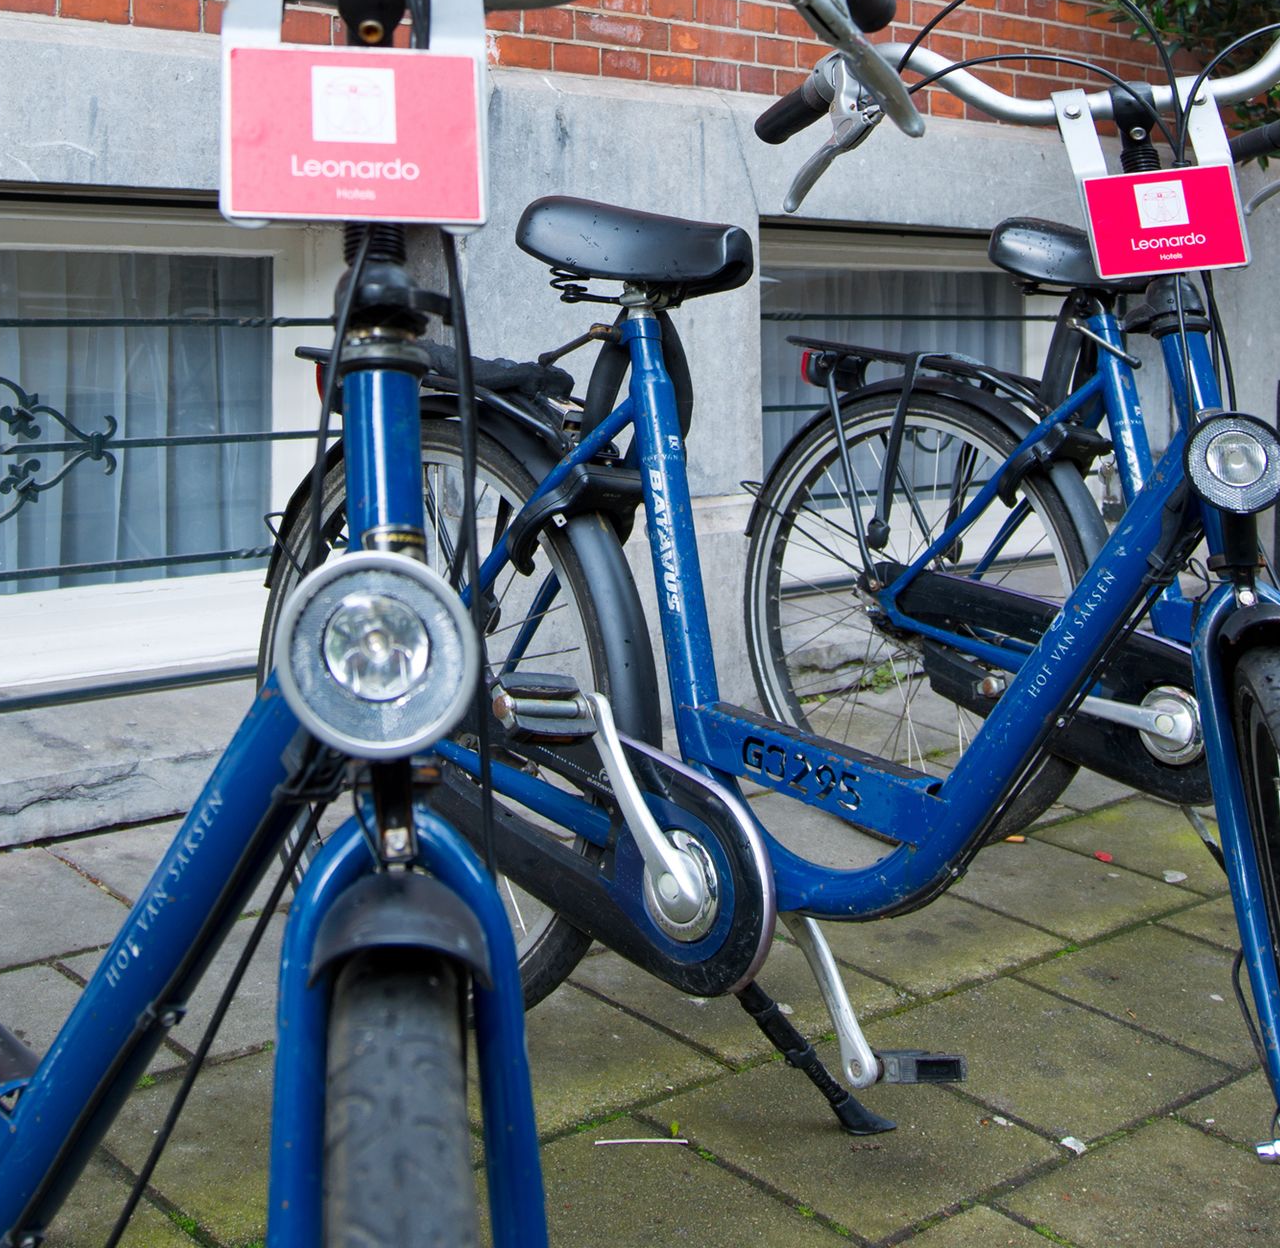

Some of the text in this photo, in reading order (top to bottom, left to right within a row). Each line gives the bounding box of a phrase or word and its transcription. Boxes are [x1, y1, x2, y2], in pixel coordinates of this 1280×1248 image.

[290, 154, 420, 181] Leonardo
[336, 187, 376, 201] Hotels
[1130, 232, 1206, 251] Leonardo
[1159, 252, 1183, 261] Hotels
[648, 467, 680, 613] BATAVUS
[1027, 663, 1054, 699] HOF
[1050, 630, 1075, 662] VAN
[1073, 570, 1118, 628] SAKSEN
[586, 776, 614, 794] BATAVU
[742, 735, 863, 811] G3295
[104, 788, 224, 988] HOF VAN SAKSEN
